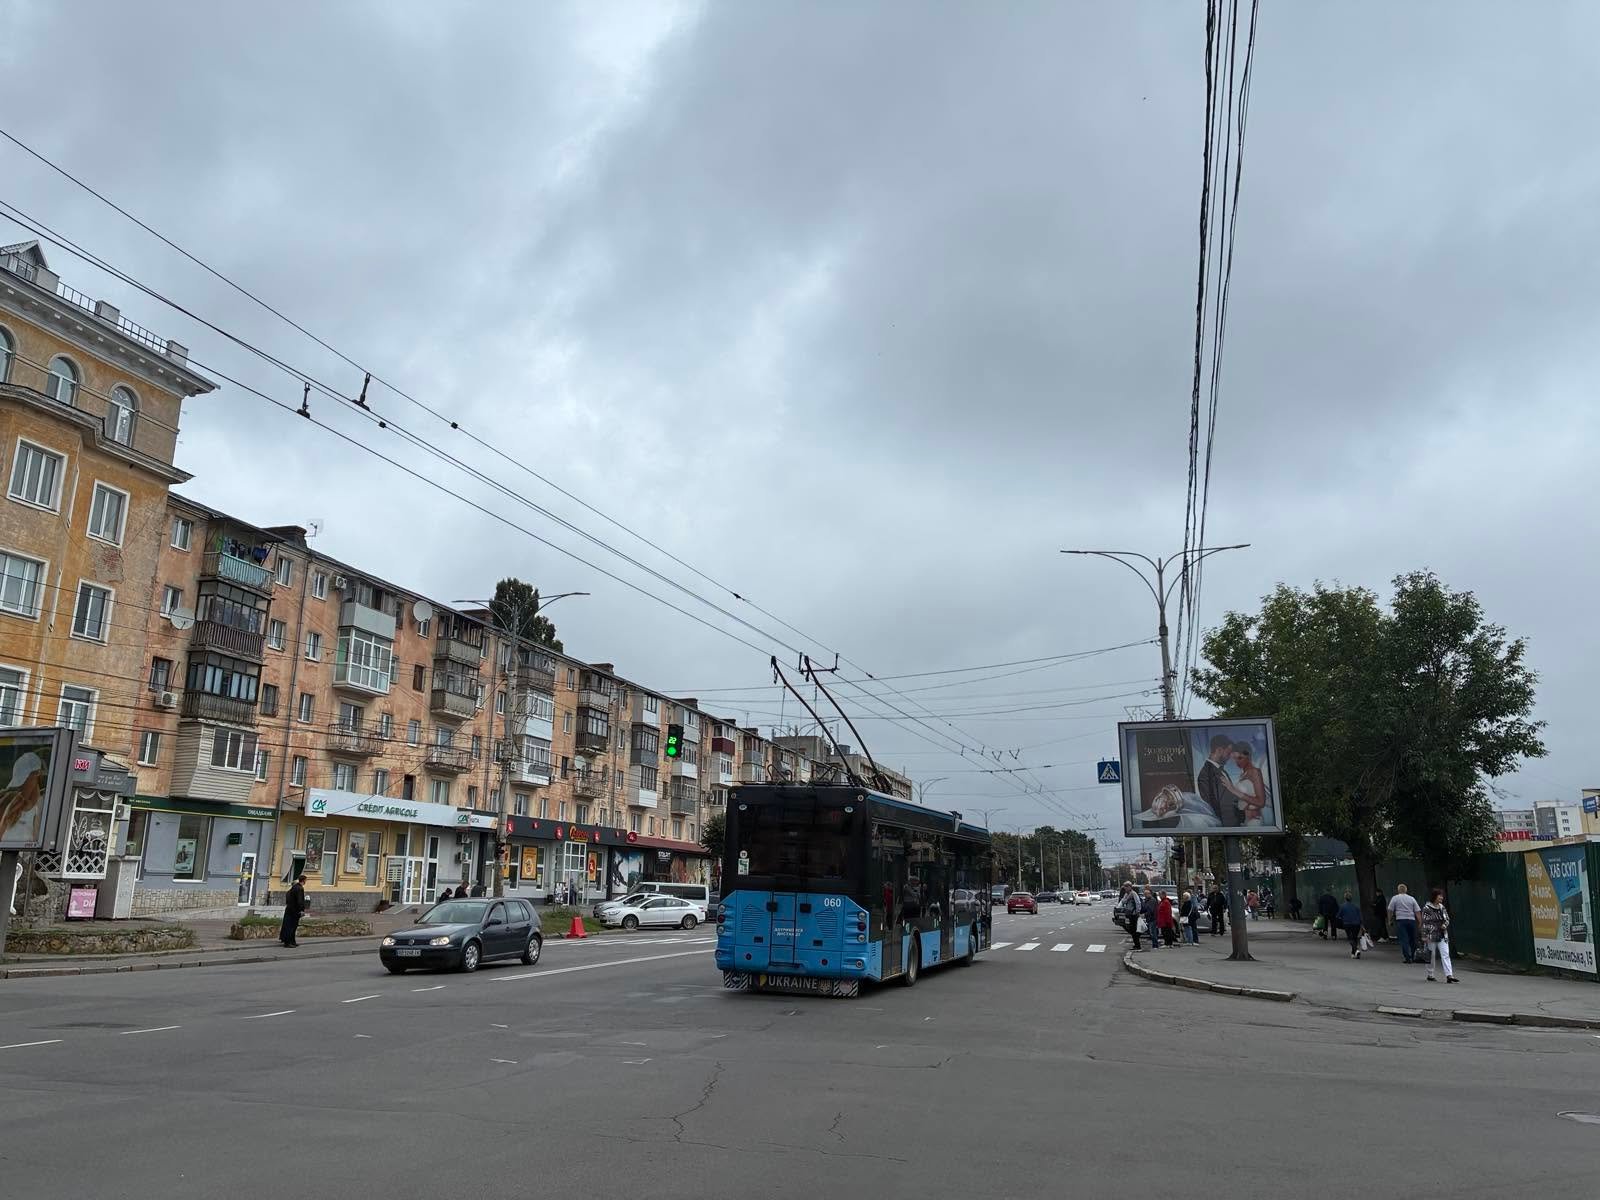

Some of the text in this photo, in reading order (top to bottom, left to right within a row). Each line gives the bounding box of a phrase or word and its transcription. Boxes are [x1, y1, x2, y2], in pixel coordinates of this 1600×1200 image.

[383, 806, 419, 817] AGRICOLE
[1549, 863, 1561, 878] ХАБ
[824, 898, 841, 907] 060
[1586, 951, 1593, 965] 15
[768, 975, 819, 990] UKRAINE
